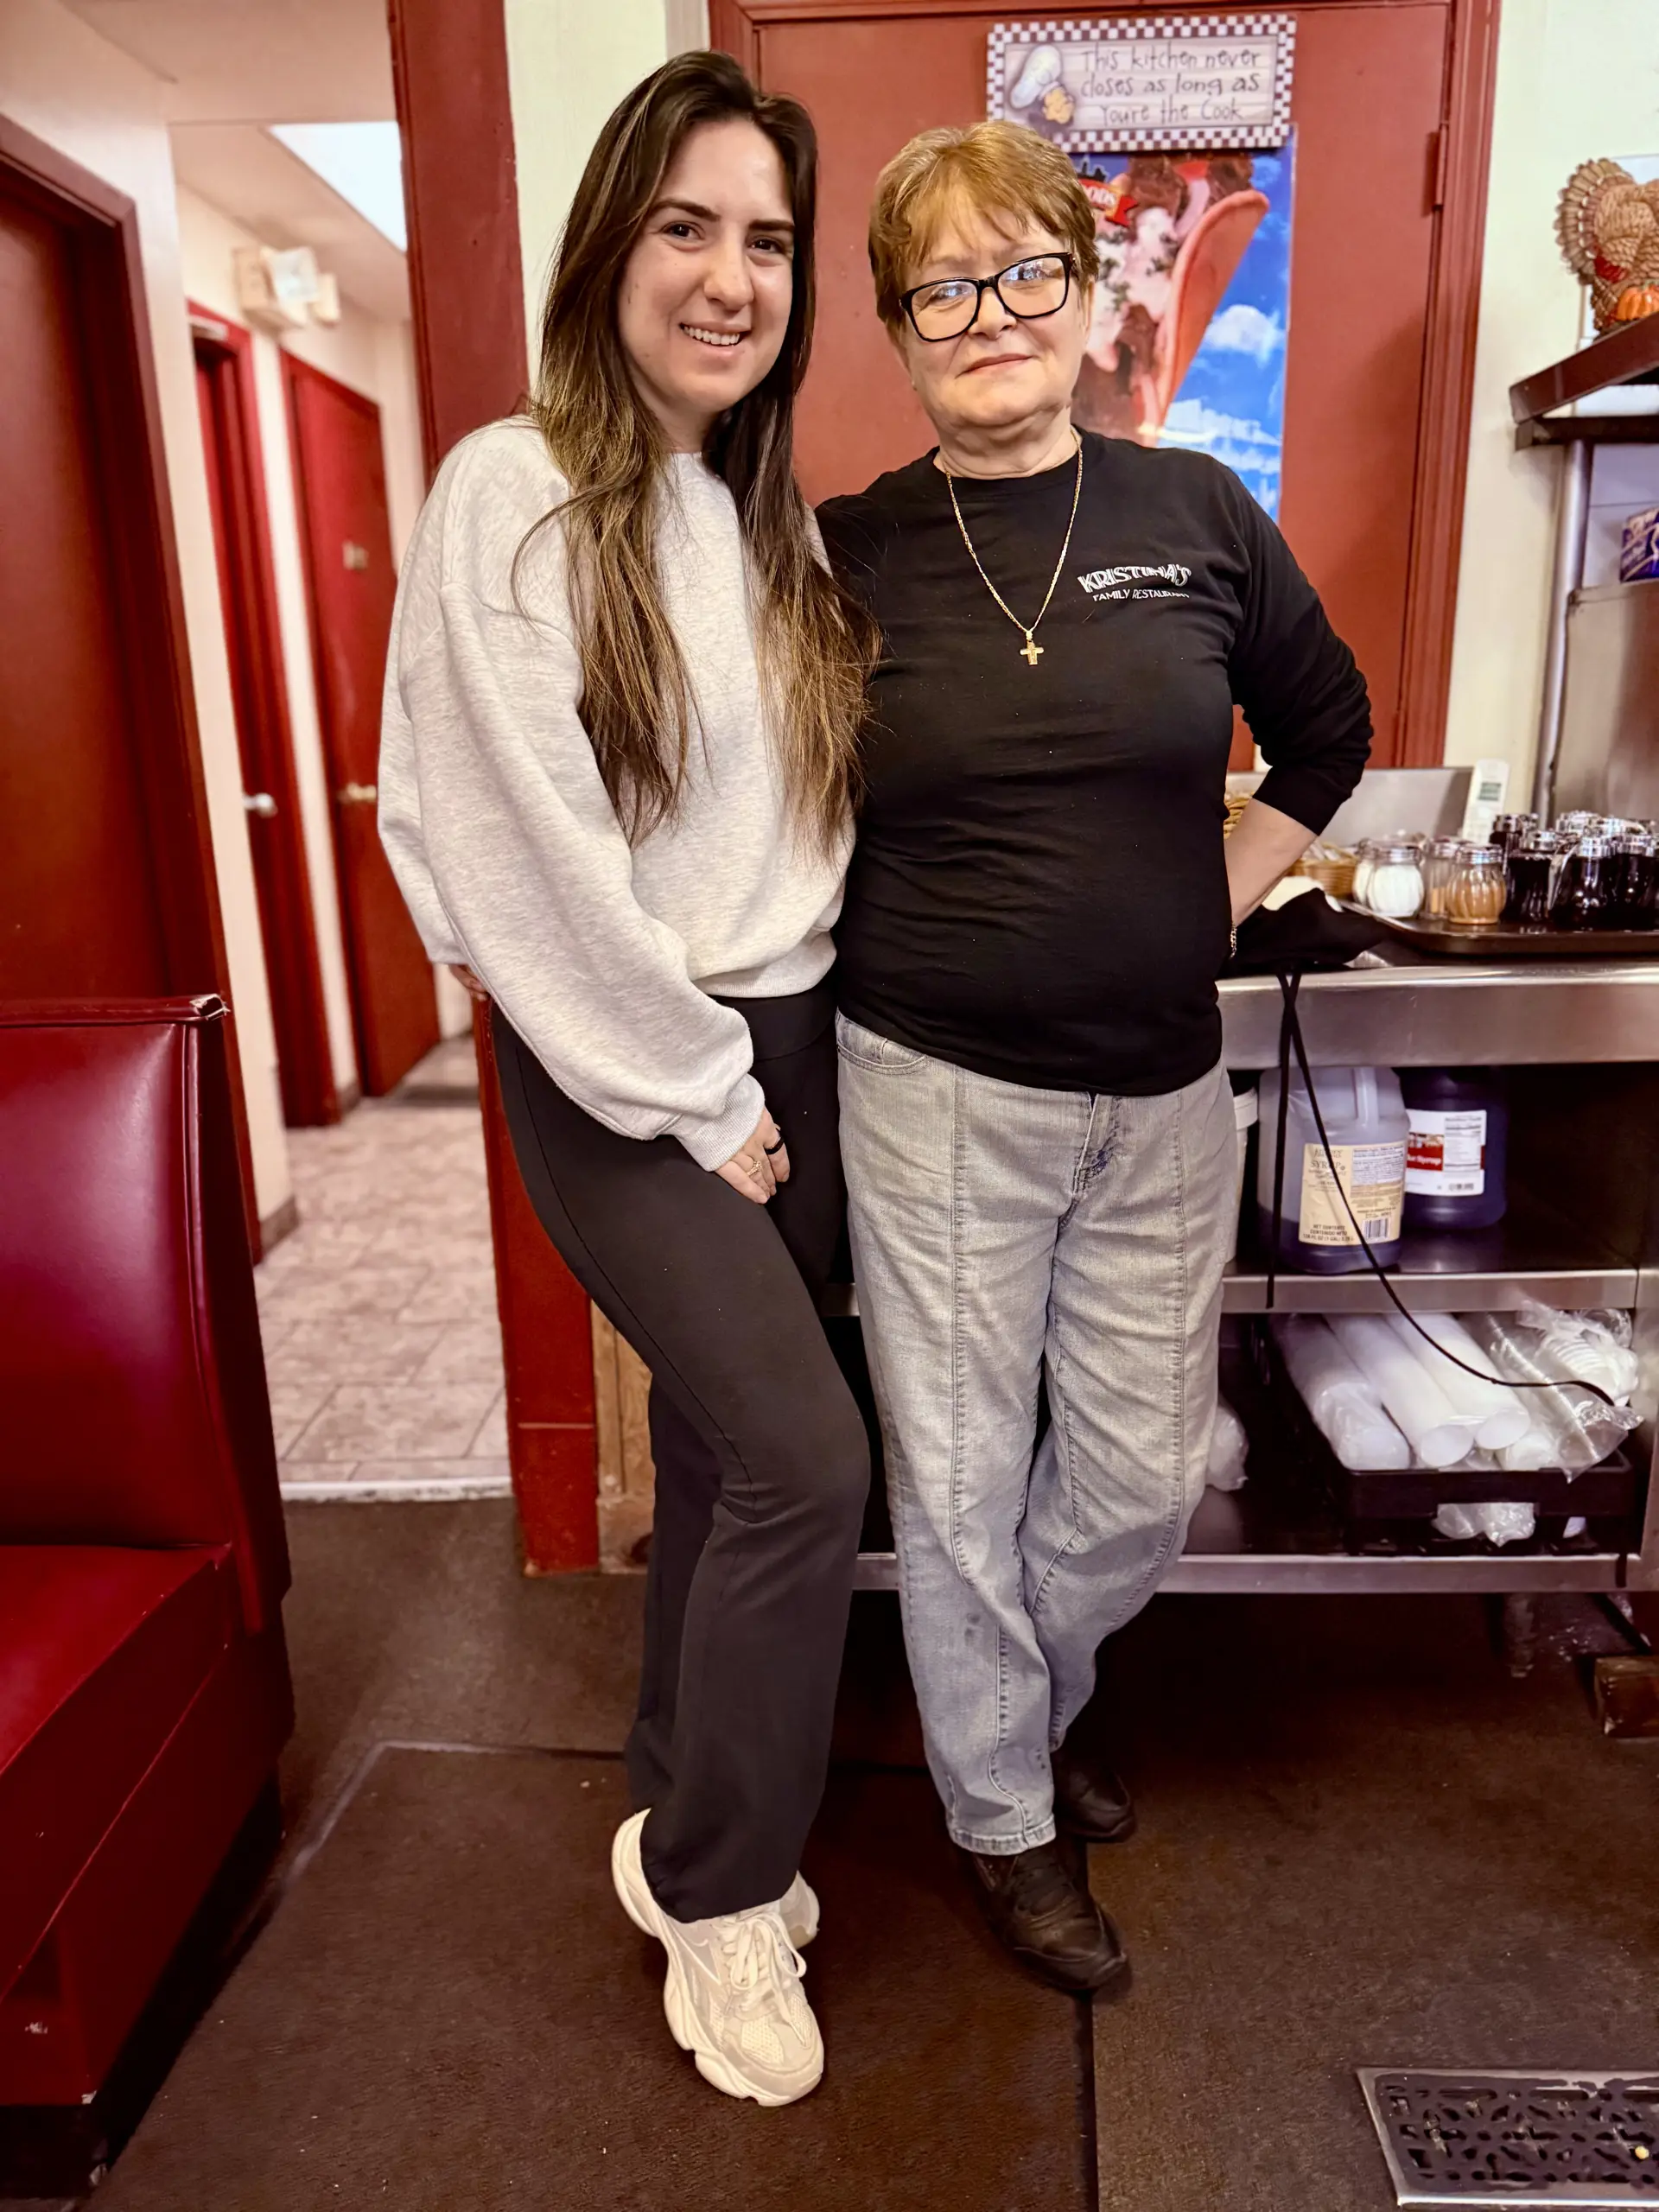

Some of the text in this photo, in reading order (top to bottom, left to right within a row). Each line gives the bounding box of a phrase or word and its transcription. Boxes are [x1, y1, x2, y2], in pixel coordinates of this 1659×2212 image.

[1080, 41, 1261, 72] This kitchen never
[1080, 73, 1261, 99] closes as long as
[1160, 94, 1189, 125] the
[1201, 98, 1243, 122] Cook
[1077, 563, 1192, 594] KRISTINA'S
[1092, 588, 1130, 602] FAMILY
[1311, 1160, 1341, 1169] SYRP
